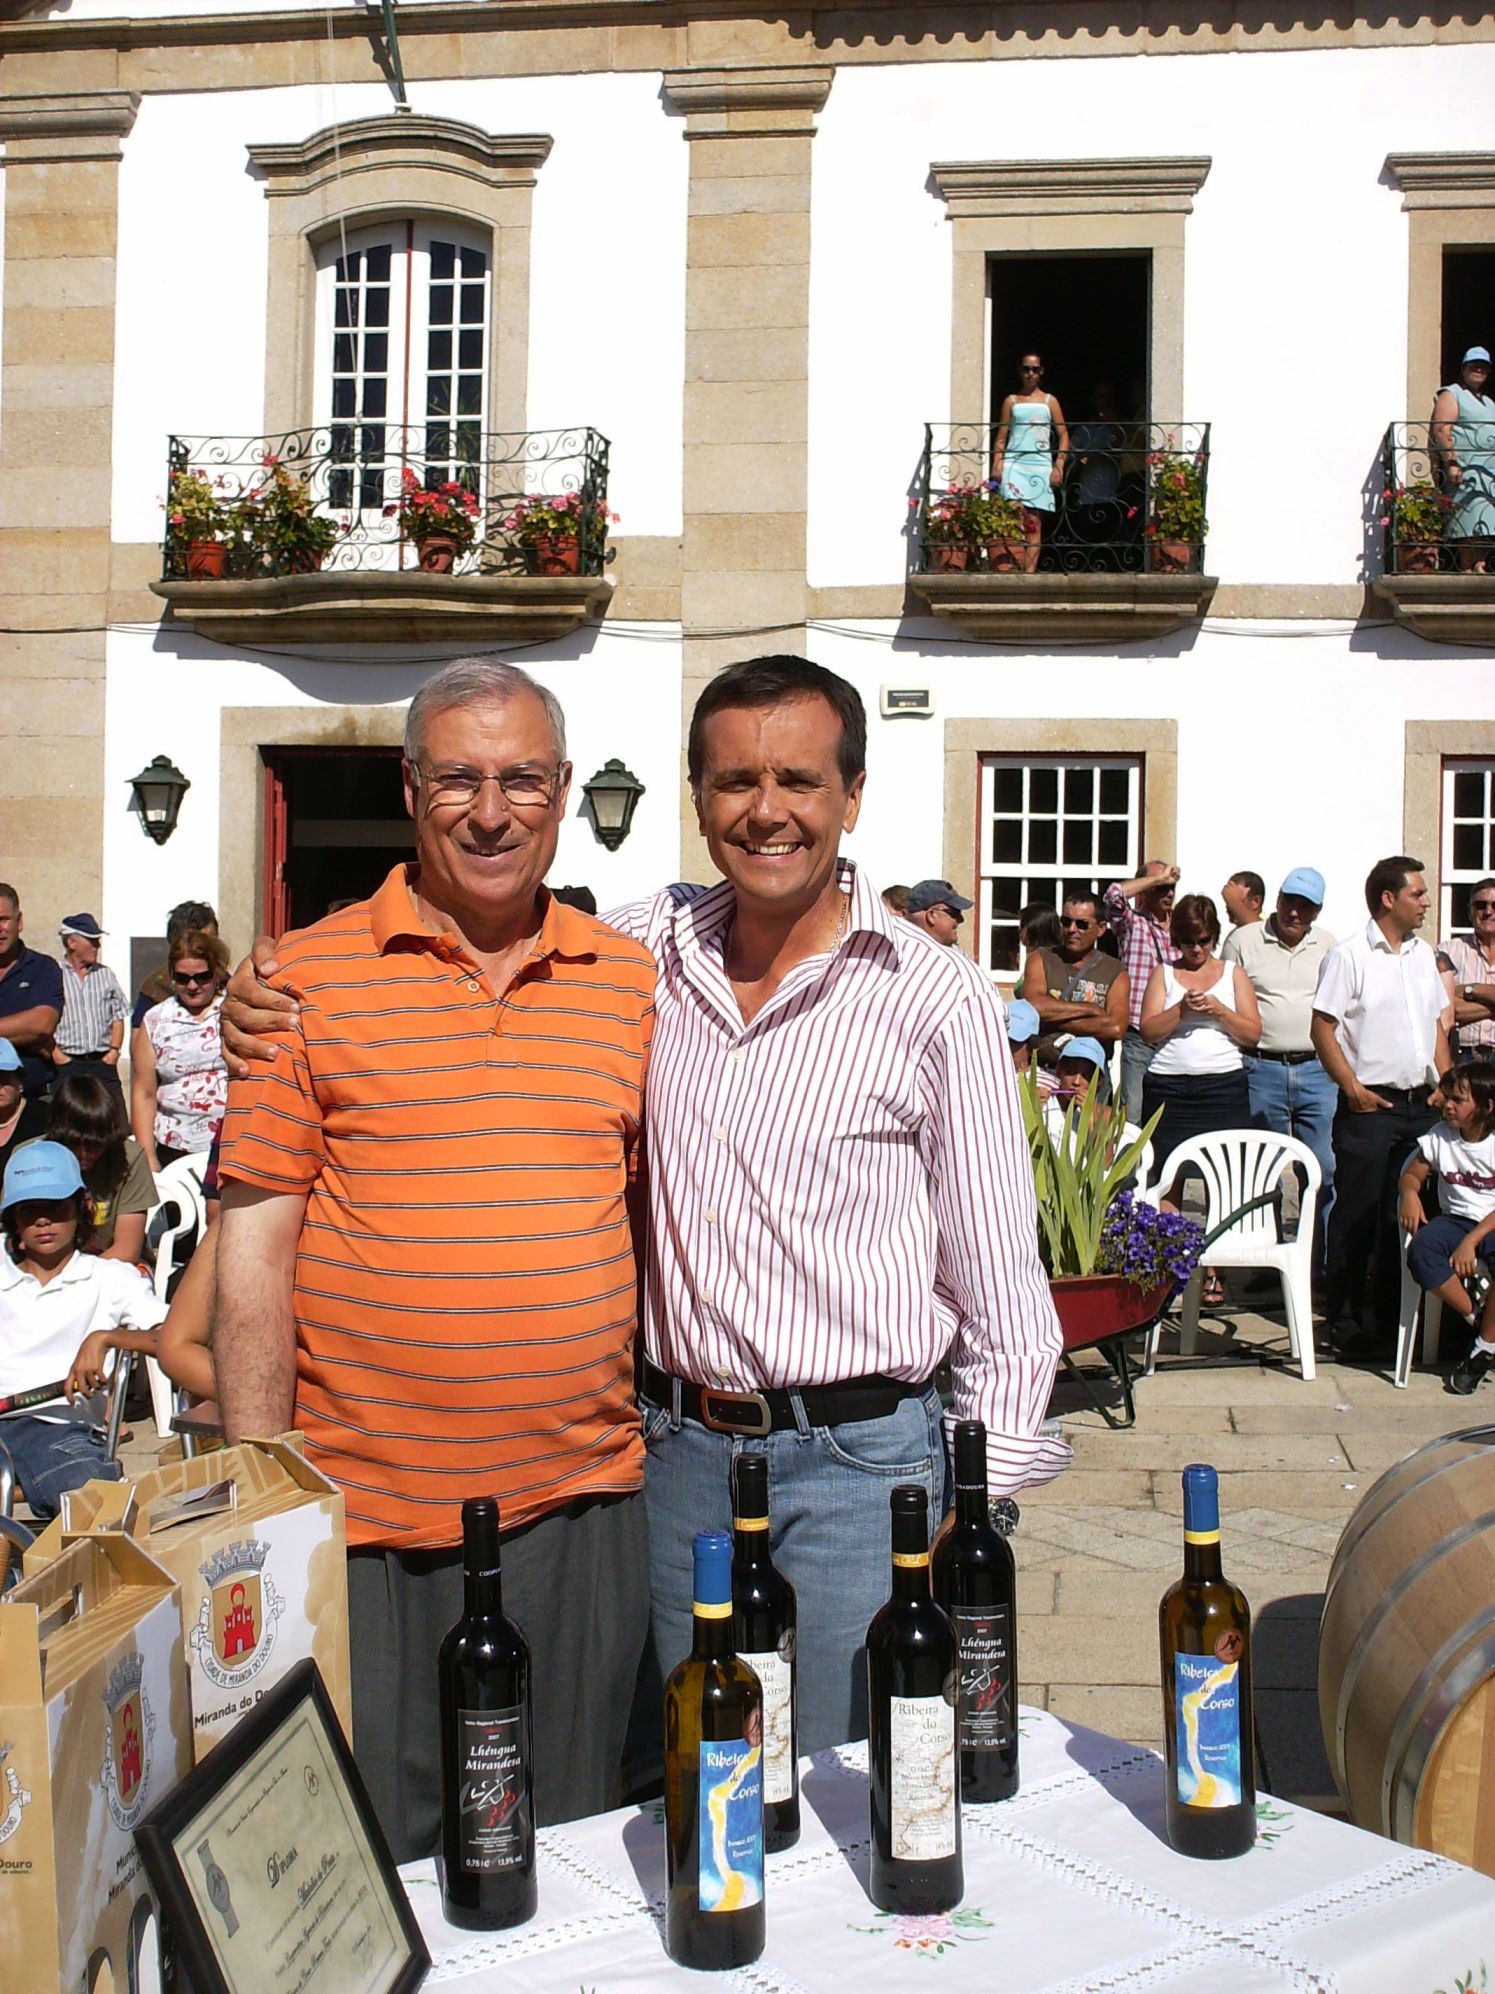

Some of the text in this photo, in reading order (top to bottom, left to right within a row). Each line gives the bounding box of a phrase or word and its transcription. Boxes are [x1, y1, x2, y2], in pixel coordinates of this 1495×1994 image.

[958, 1648, 1006, 1660] Mirandesa
[749, 1658, 776, 1670] beira
[898, 1703, 939, 1716] Ribeira
[1200, 1697, 1235, 1711] Corso
[194, 1701, 237, 1729] Miranda
[239, 1695, 253, 1708] do
[922, 1717, 937, 1730] do
[920, 1731, 951, 1745] Corso
[470, 1744, 517, 1760] Lhéngua
[465, 1756, 522, 1771] Mirandesa
[729, 1783, 760, 1801] Corso
